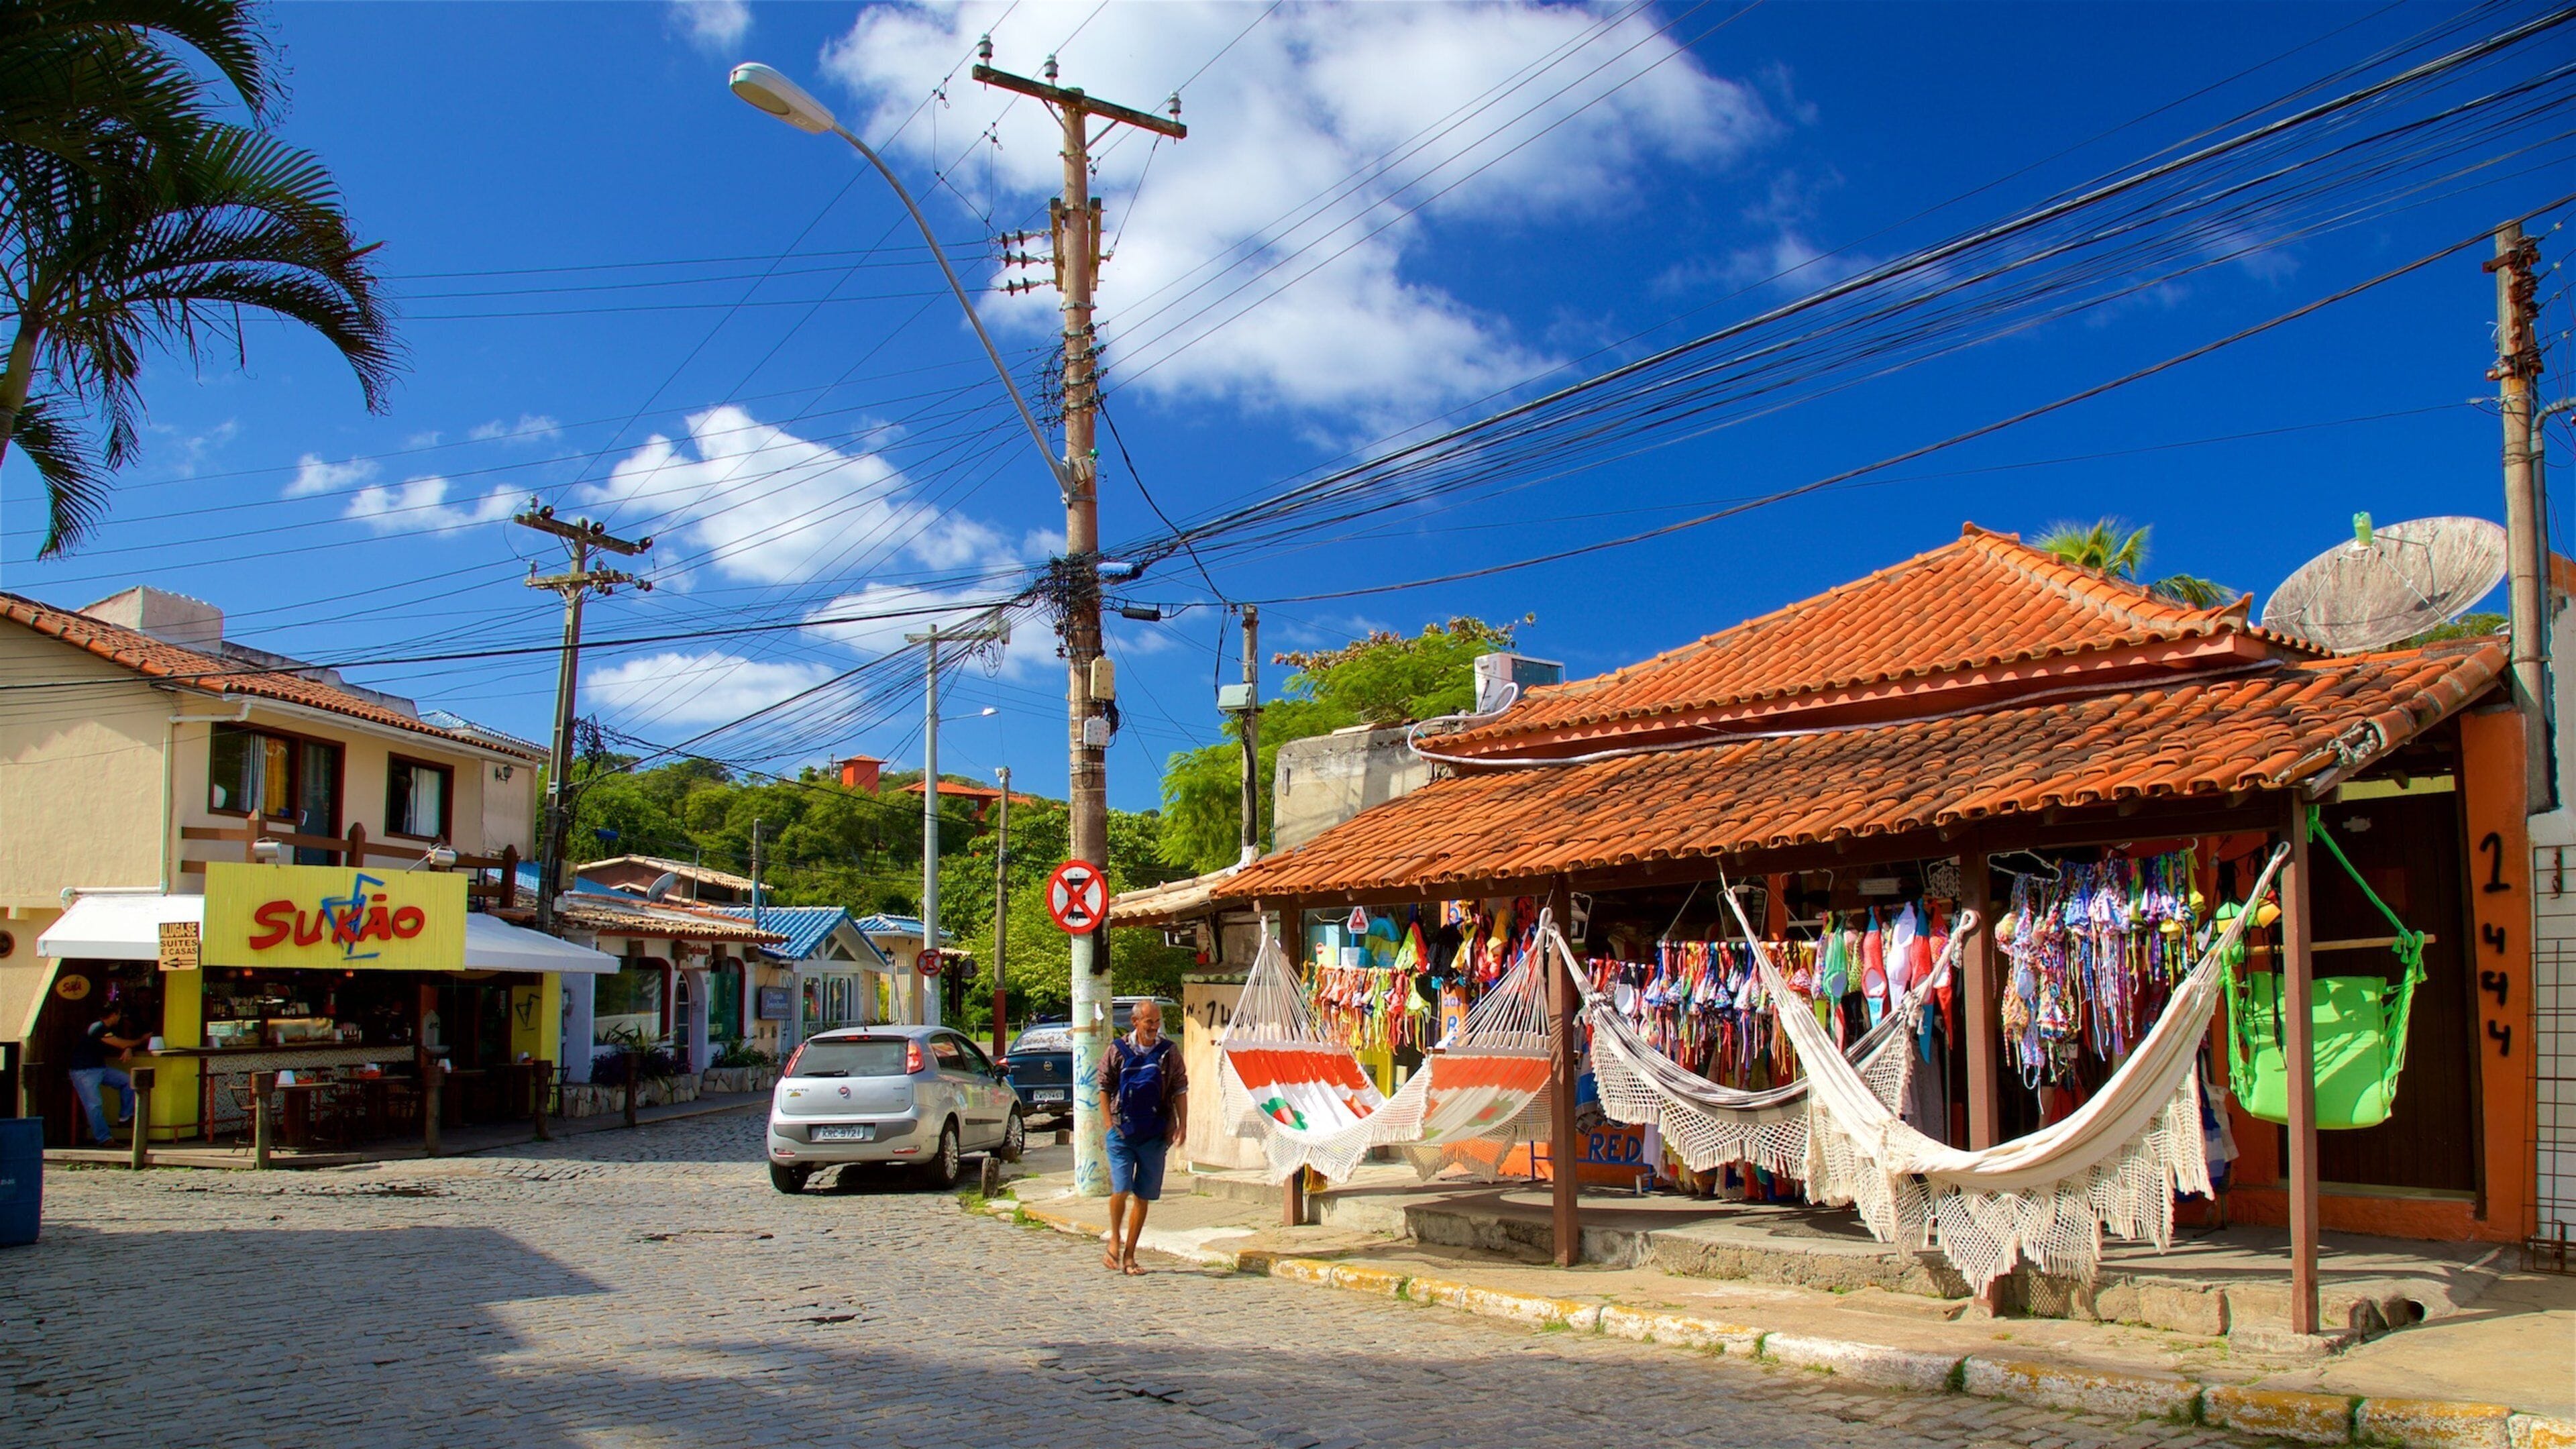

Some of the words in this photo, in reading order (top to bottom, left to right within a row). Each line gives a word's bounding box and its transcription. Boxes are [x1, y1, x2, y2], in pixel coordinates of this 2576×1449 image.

[160, 923, 197, 936] ALUGA-SE
[249, 894, 425, 950] SUKÃO
[1589, 1133, 1642, 1162] RED
